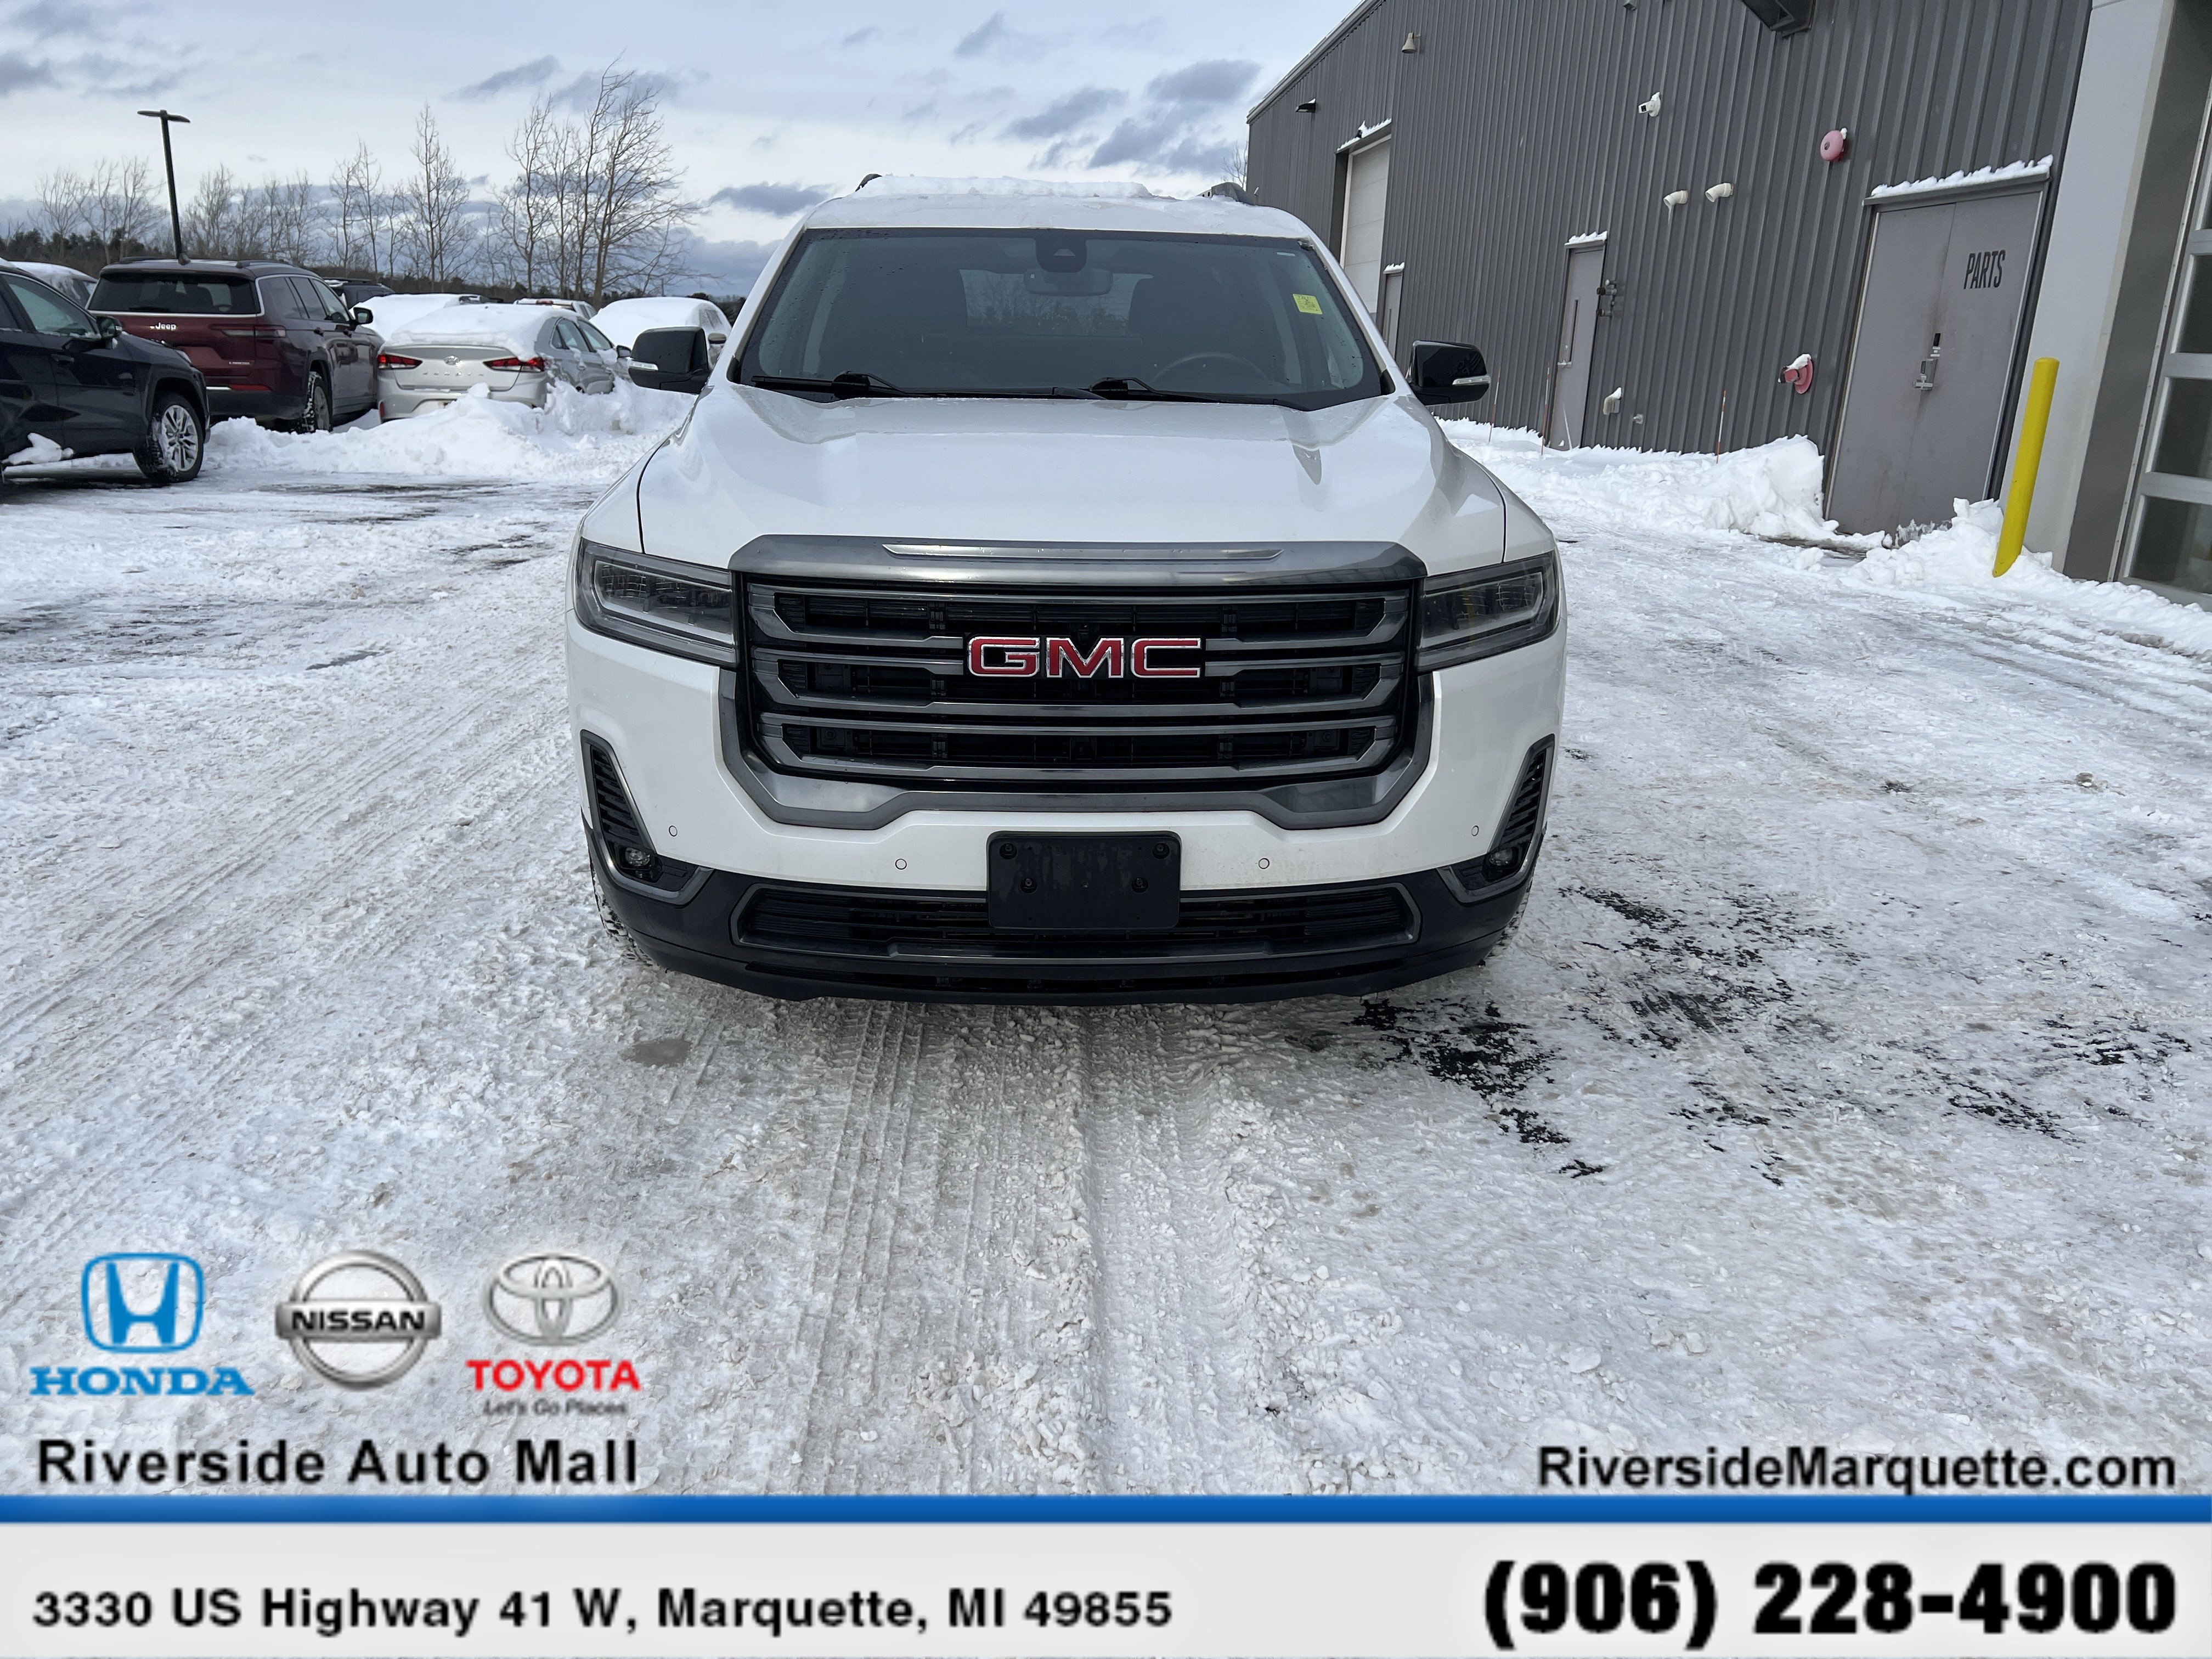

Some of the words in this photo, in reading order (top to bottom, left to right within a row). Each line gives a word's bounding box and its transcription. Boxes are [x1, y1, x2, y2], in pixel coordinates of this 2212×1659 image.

[1963, 249, 2006, 290] PARTS
[155, 322, 177, 331] Jeep
[967, 636, 1202, 678] GMC
